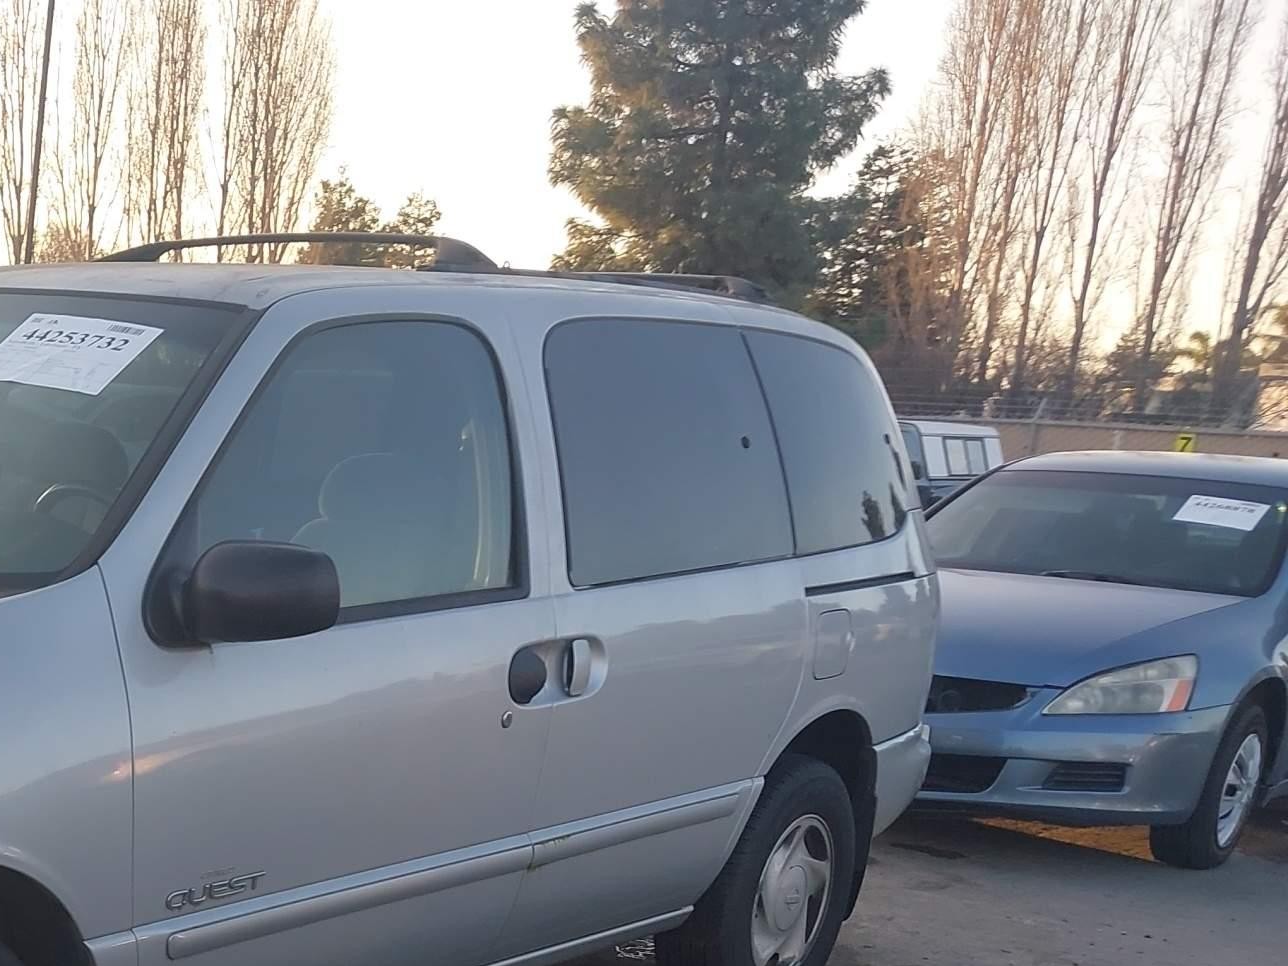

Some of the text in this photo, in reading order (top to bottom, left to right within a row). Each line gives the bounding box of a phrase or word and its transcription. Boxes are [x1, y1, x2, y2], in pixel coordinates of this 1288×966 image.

[22, 328, 130, 352] 44253732
[1179, 436, 1193, 453] 7
[165, 870, 267, 912] QUEST
